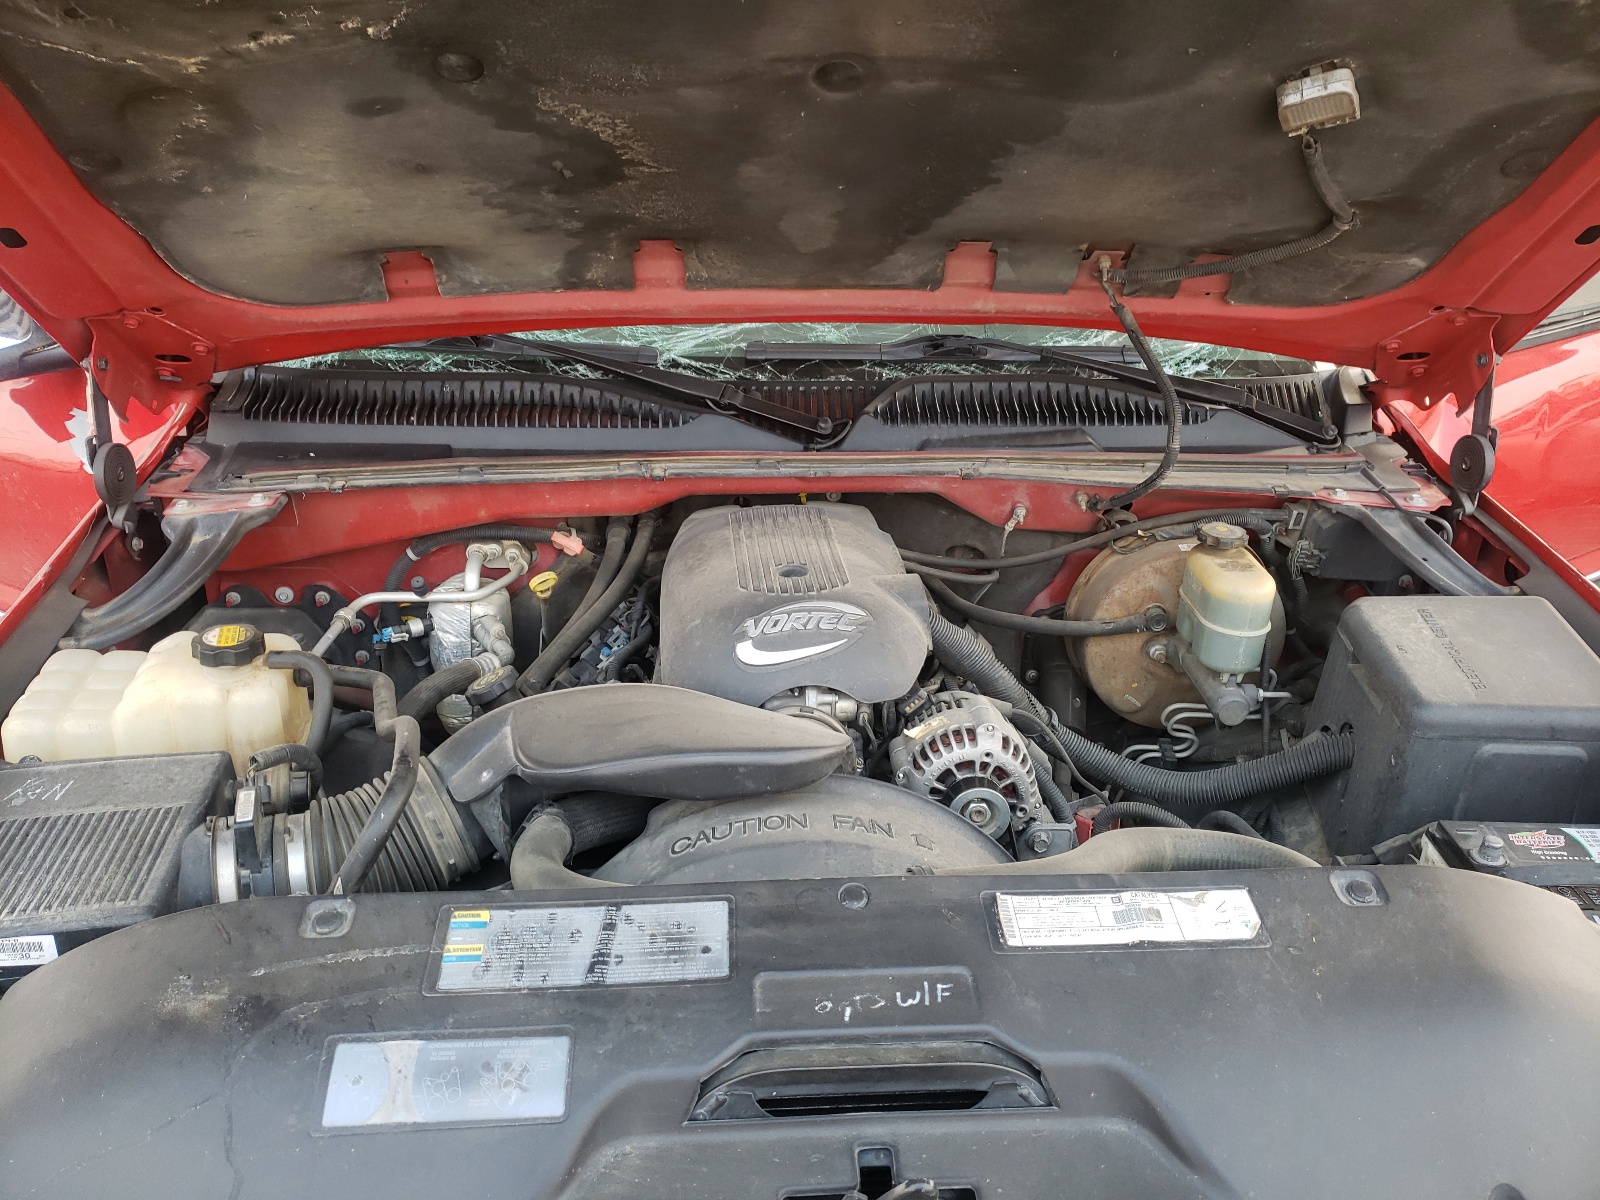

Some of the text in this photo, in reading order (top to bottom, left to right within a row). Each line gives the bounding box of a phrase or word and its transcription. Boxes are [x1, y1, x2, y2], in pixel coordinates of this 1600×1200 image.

[743, 611, 867, 638] VORTEC
[1417, 608, 1488, 690] ELECTRICAL CENTER
[669, 812, 895, 857] CAUTION FAN
